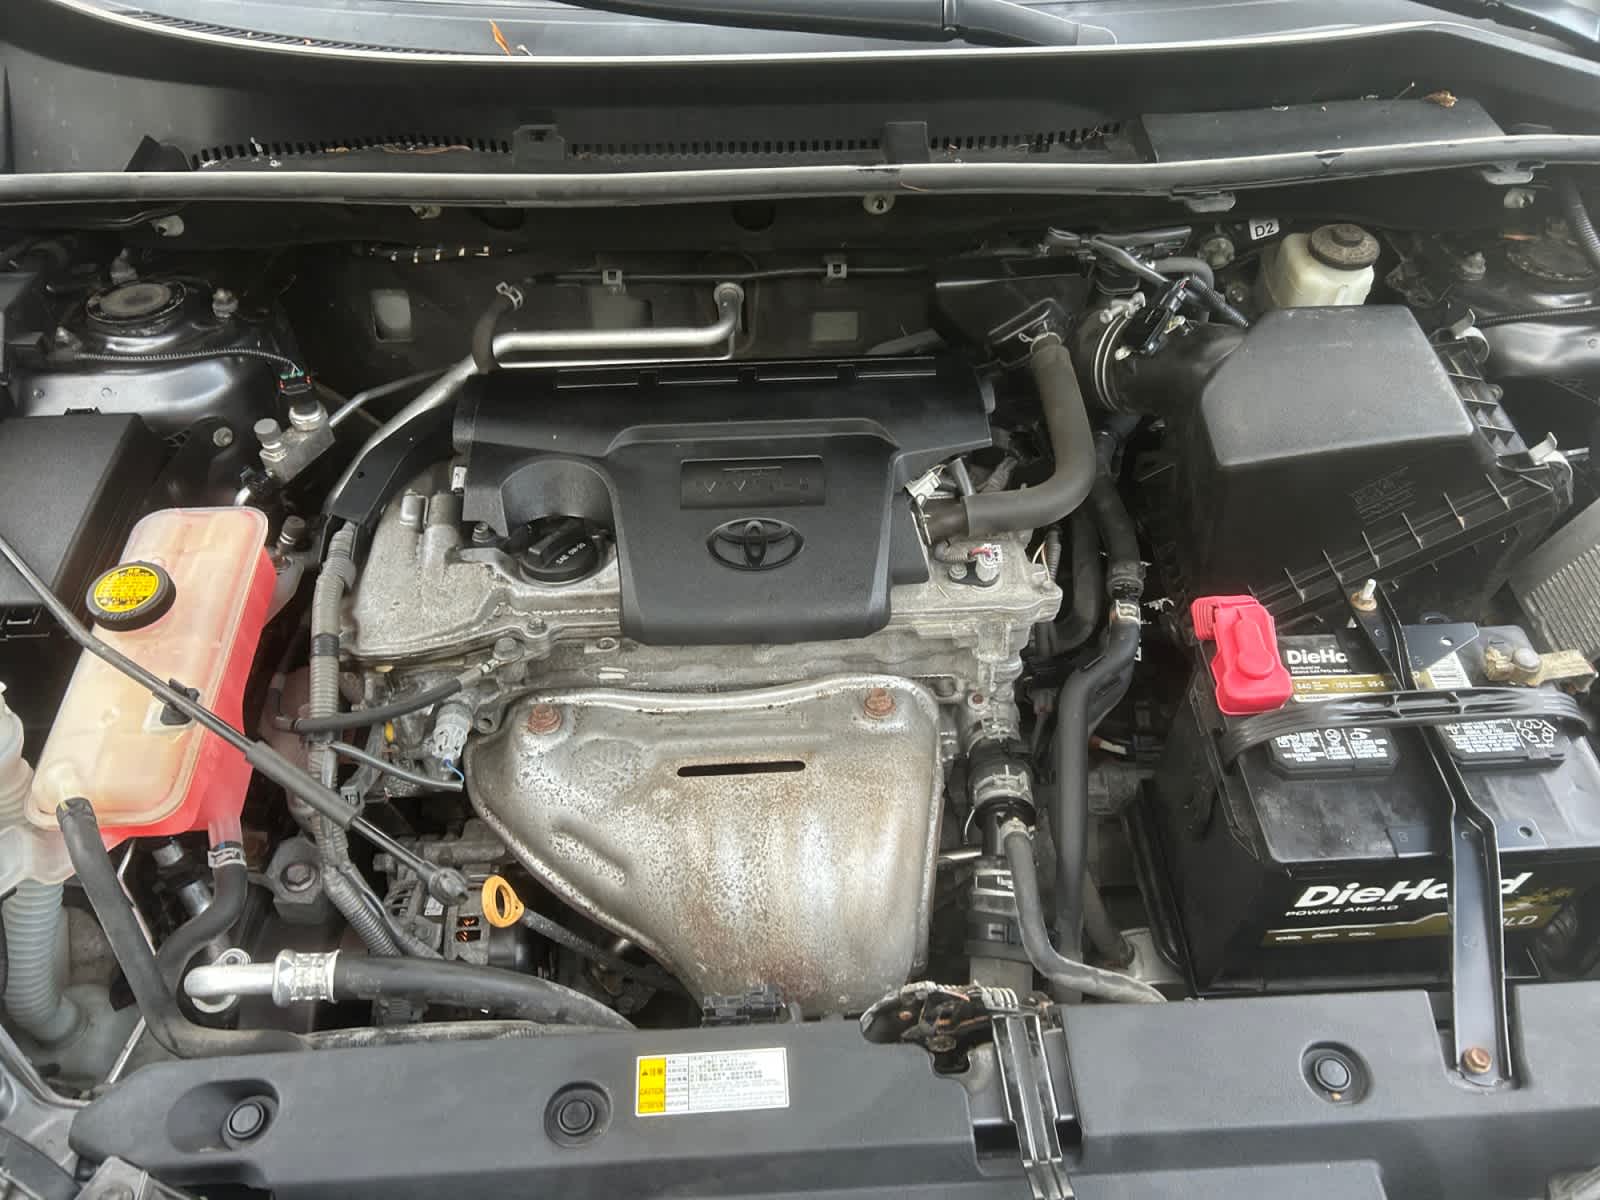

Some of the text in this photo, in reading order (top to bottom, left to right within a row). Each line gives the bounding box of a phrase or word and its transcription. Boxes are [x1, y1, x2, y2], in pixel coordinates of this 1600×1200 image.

[1255, 223, 1274, 237] D2
[1286, 648, 1348, 665] DieHa
[1294, 871, 1534, 907] DieHad
[1285, 904, 1399, 917] POWER AHEAD
